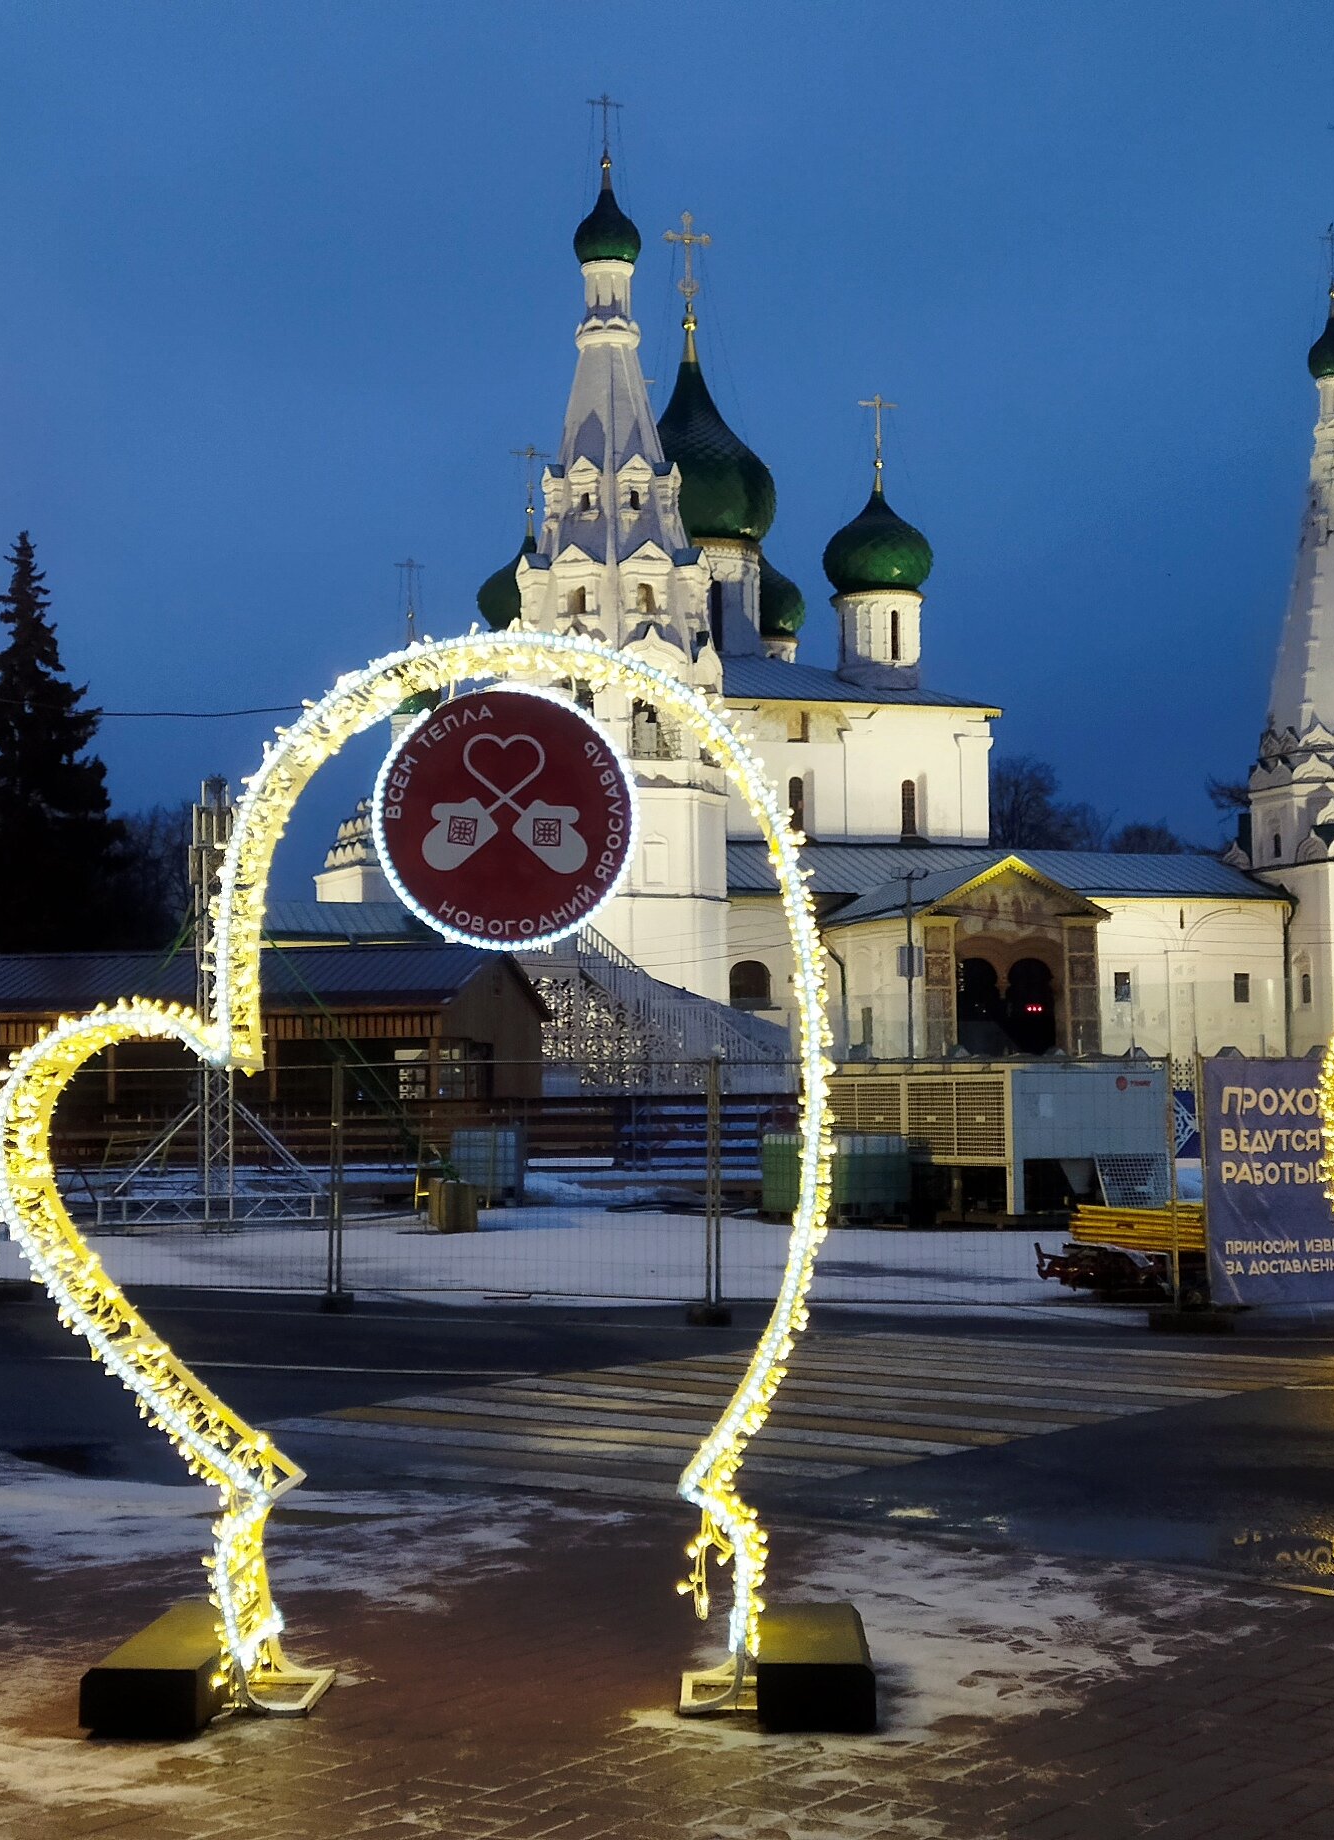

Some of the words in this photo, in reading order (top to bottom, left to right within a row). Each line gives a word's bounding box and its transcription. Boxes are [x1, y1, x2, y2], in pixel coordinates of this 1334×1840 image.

[385, 757, 419, 820] ВСЕМ
[415, 704, 495, 750] ТЕПЛА
[437, 883, 597, 936] НОВОГОДНИЙ
[582, 740, 626, 883] ЯРОСЛАВЛЬ
[1220, 1128, 1321, 1154] ВЕДУТСЯ
[1225, 1239, 1300, 1255] ПРИНОСИМ
[1225, 1260, 1244, 1276] ЗА
